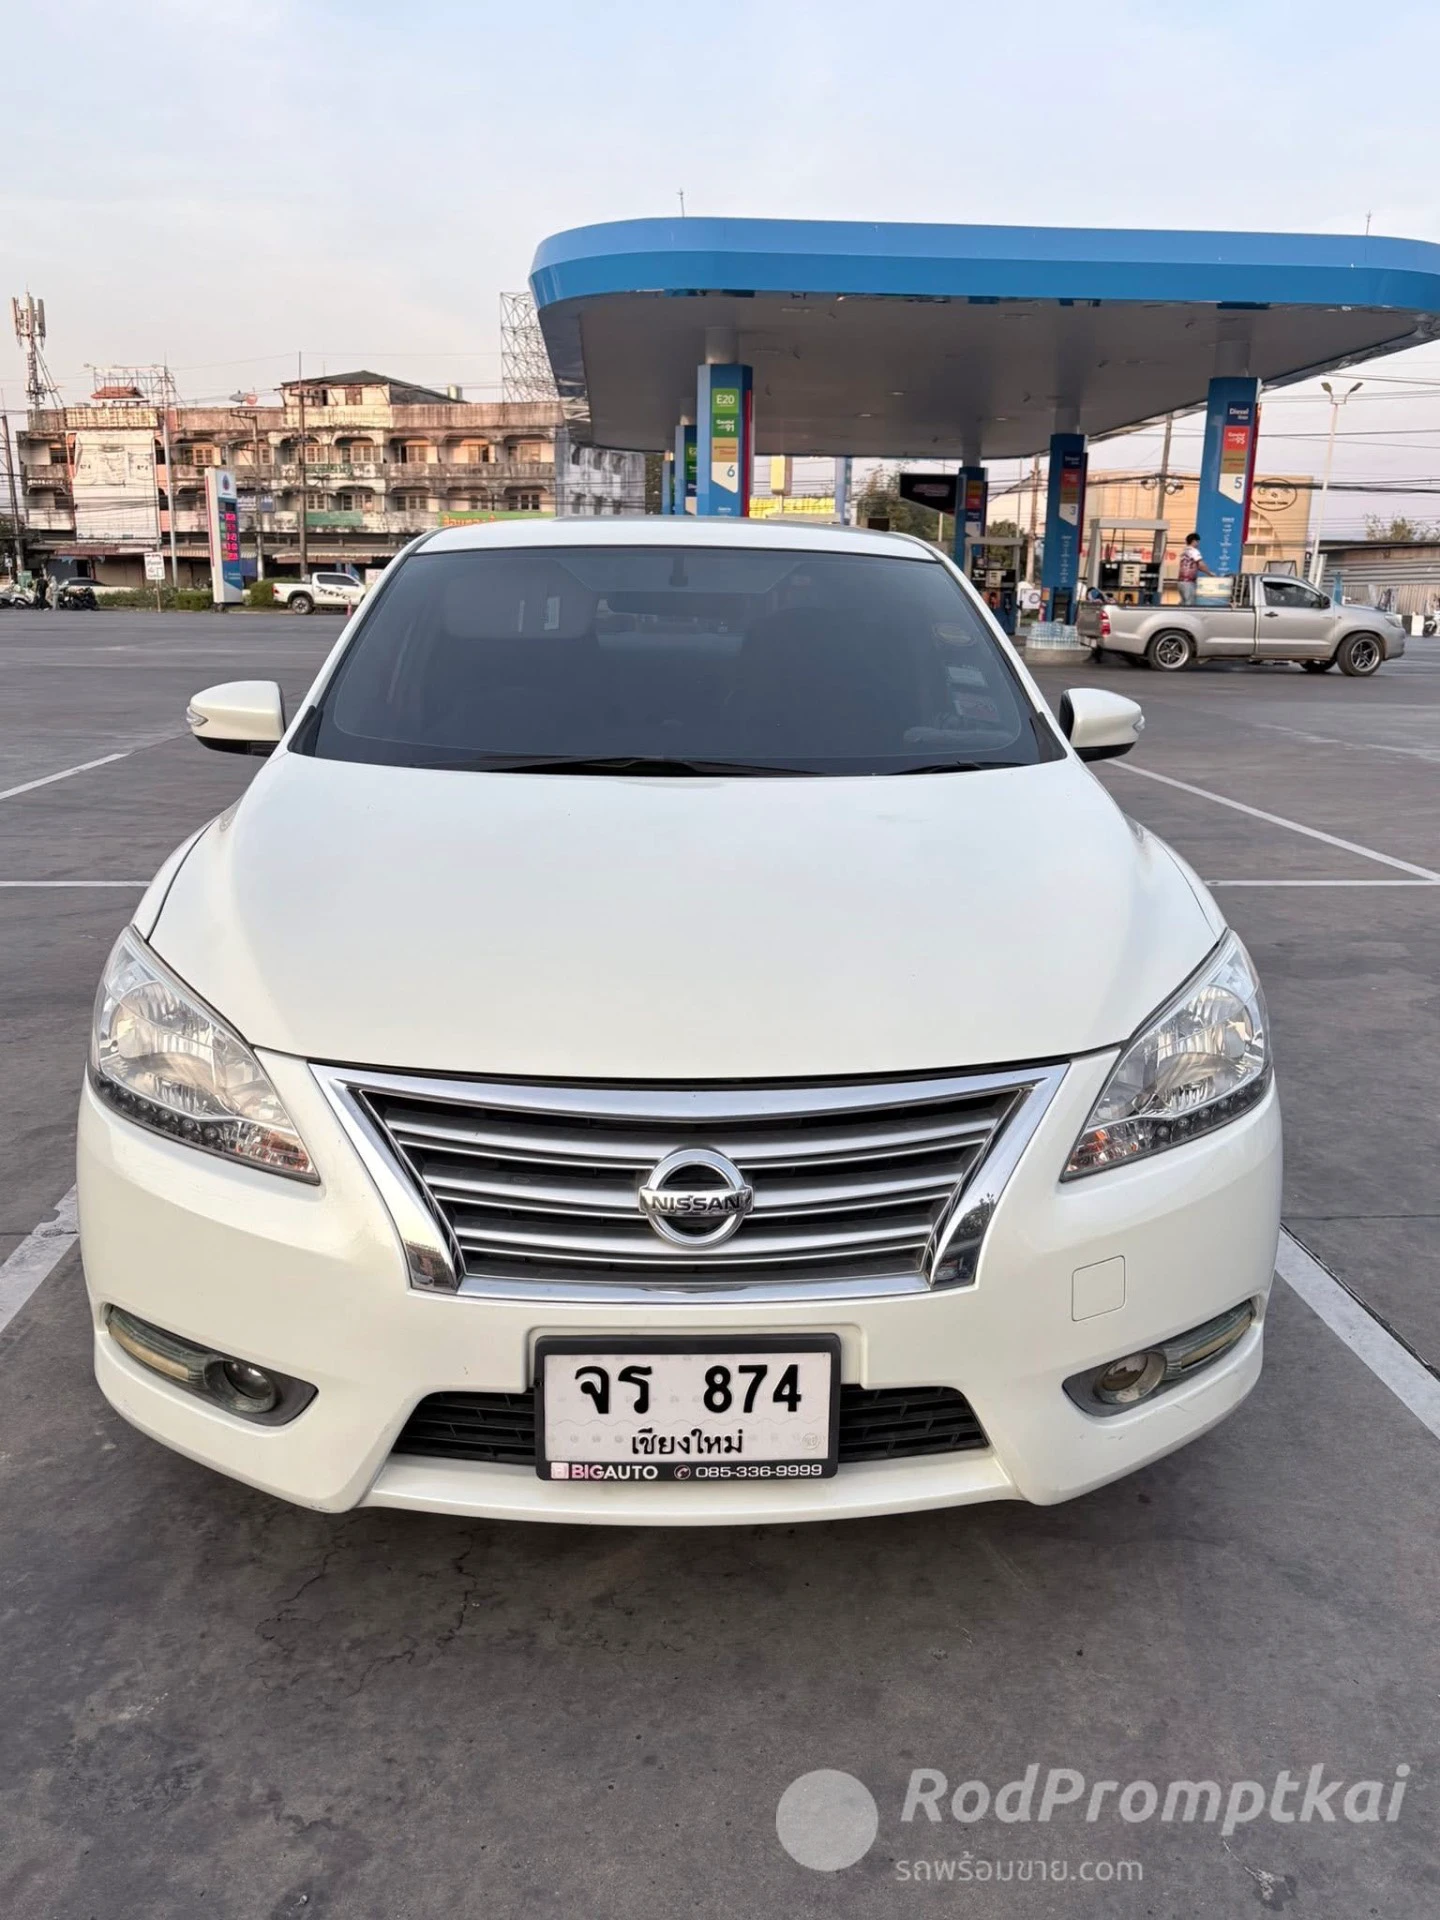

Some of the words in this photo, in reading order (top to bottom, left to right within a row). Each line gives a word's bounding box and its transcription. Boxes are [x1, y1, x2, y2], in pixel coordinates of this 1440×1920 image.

[716, 394, 735, 404] E20
[1229, 407, 1249, 415] Diesel
[726, 465, 735, 478] 6
[1234, 477, 1242, 489] 5
[652, 1194, 742, 1213] NISSAN
[575, 1365, 653, 1415] จร
[703, 1364, 802, 1413] 874
[632, 1428, 743, 1455] เชียงใหม่
[571, 1464, 659, 1480] BIGAUTO
[696, 1464, 823, 1479] 085-336-9999
